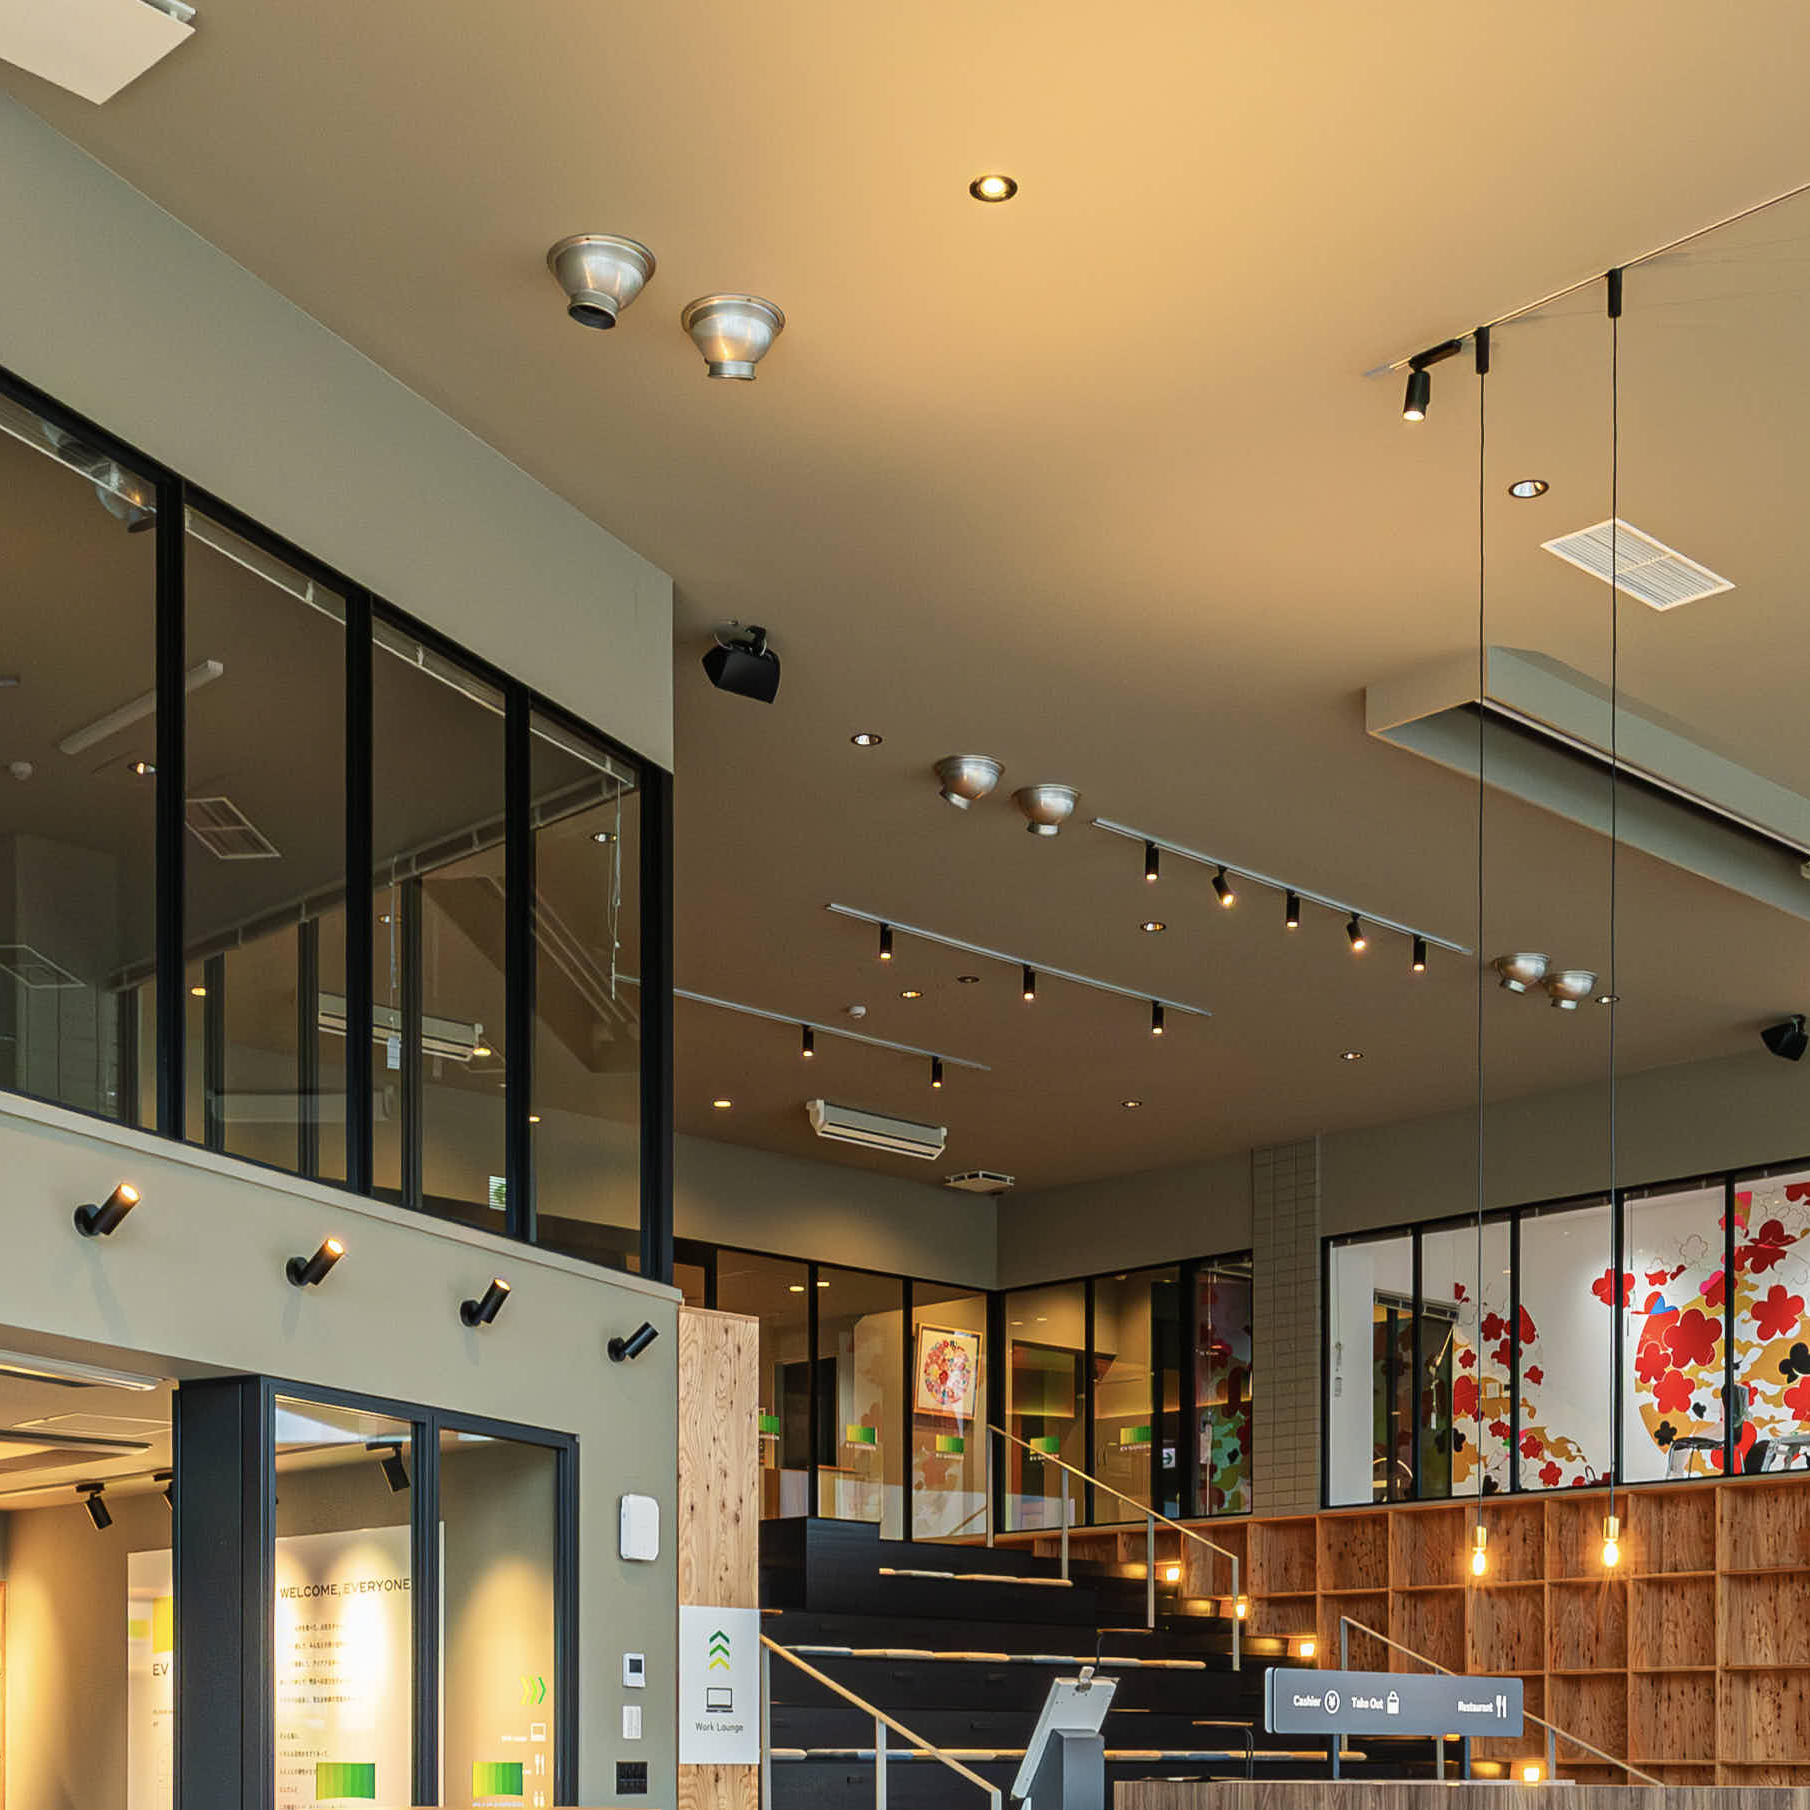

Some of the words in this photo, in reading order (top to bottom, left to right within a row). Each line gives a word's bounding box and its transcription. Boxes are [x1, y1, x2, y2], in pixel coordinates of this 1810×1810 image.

[279, 1583, 342, 1599] WELCOME,
[152, 1663, 169, 1676] EV
[1293, 1694, 1321, 1708] Cashier
[1351, 1696, 1368, 1710] Take
[1369, 1698, 1383, 1710] Out
[1457, 1700, 1494, 1713] Restaurant
[695, 1721, 714, 1731] Work
[716, 1721, 744, 1734] Lounge
